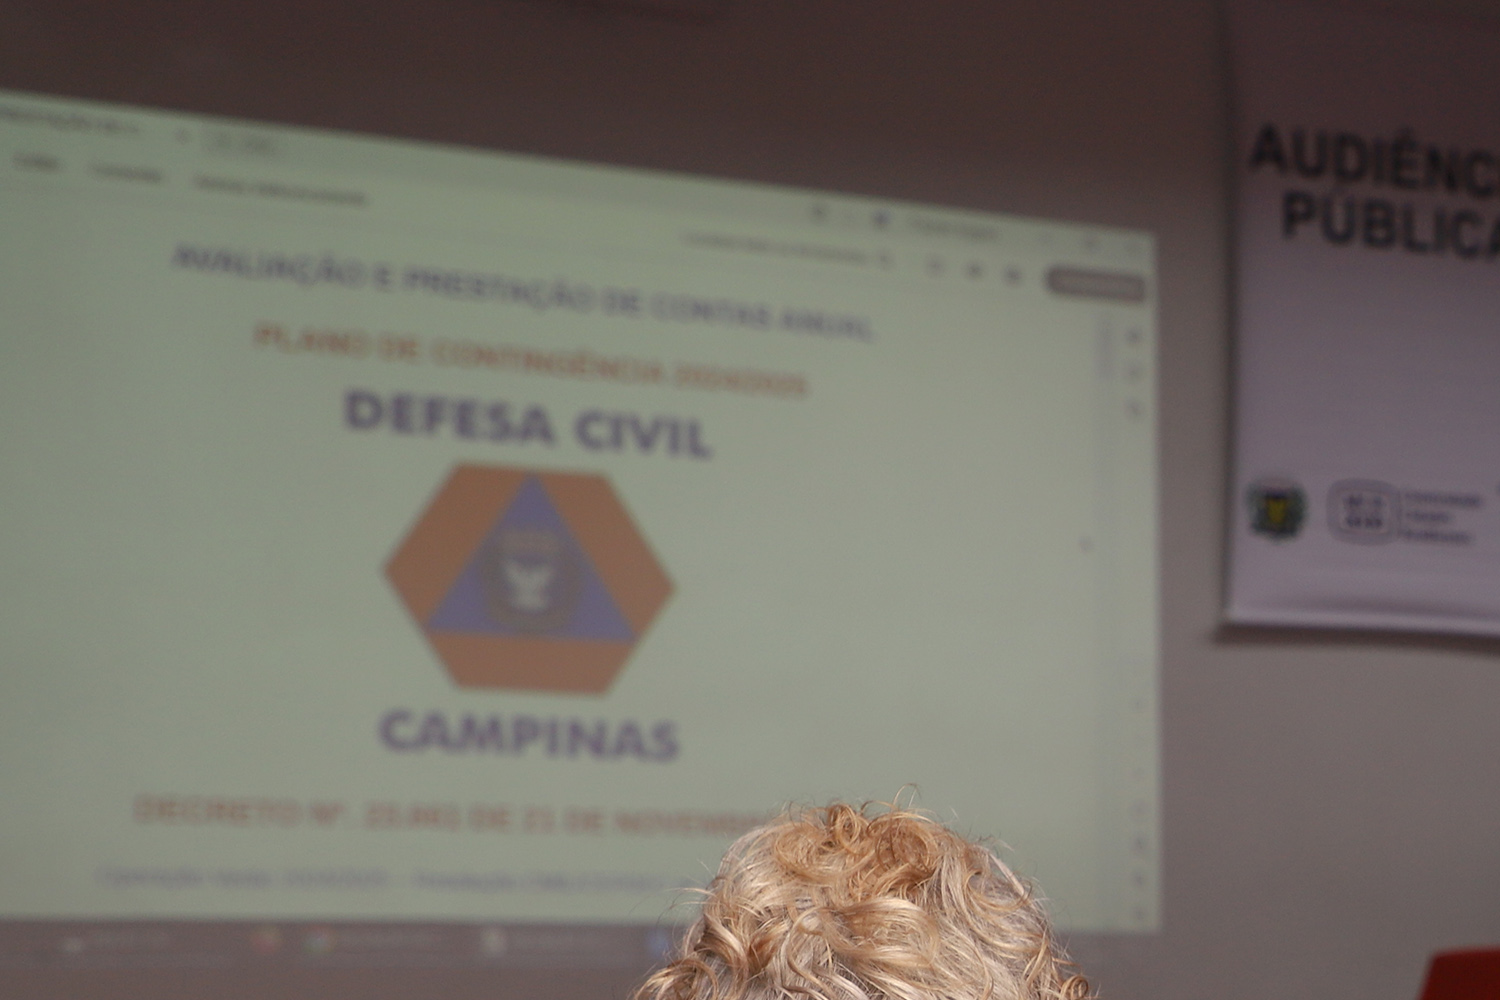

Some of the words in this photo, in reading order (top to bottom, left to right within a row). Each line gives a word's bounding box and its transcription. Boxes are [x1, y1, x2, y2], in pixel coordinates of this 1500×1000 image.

[170, 242, 367, 288] AVALIAÇÃO
[372, 260, 392, 292] E
[402, 264, 598, 312] PRESTAÇÃO
[602, 284, 643, 319] DE
[649, 290, 772, 331] CONTAS
[777, 306, 878, 344] ANUAL
[253, 320, 373, 360] PLANO
[376, 330, 422, 365] DE
[428, 337, 666, 385] CONTINGÊNCIA
[344, 388, 557, 447] DEFESA
[573, 409, 714, 461] CIVIL
[377, 708, 682, 764] CAMPINAS
[131, 791, 304, 829] DECRETO
[466, 801, 514, 835] DE
[562, 804, 606, 837] DE
